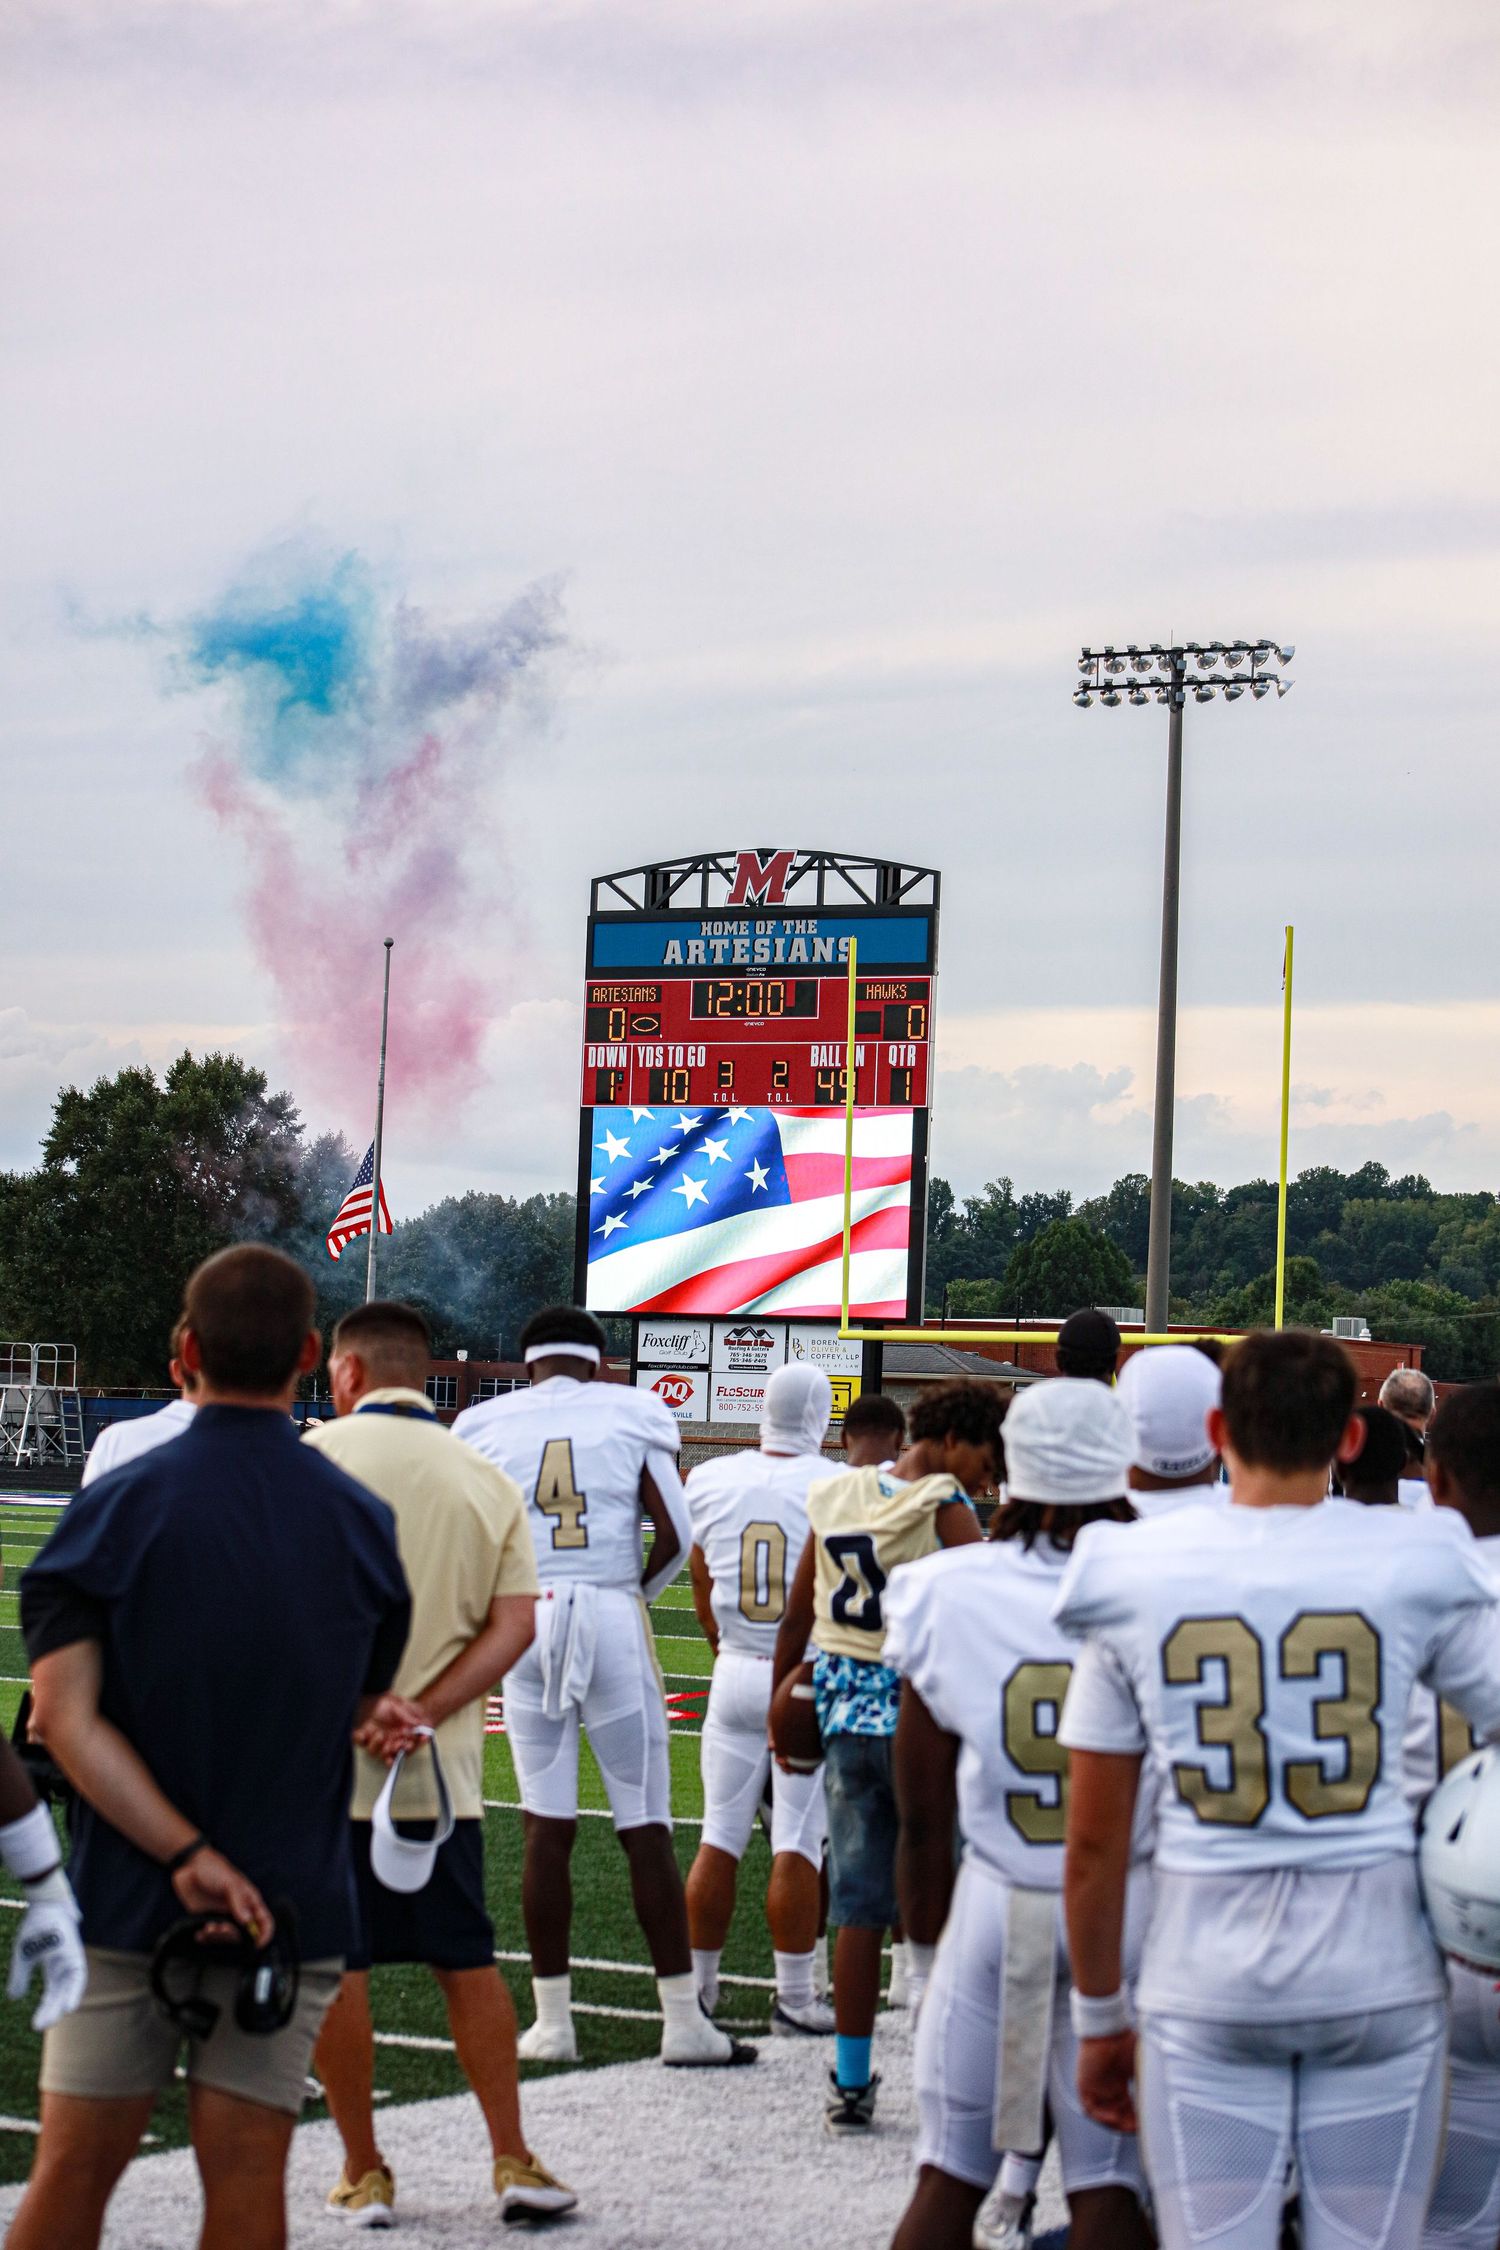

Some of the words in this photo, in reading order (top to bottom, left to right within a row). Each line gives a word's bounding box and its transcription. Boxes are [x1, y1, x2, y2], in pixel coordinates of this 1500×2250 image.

[725, 849, 798, 906] M
[701, 921, 749, 936] HOME
[755, 920, 776, 935] OF
[783, 919, 818, 935] THE
[662, 937, 850, 965] ARTESIANS
[592, 987, 657, 1002] ARTESIANS
[707, 981, 785, 1016] 12:00
[866, 984, 907, 999] HAWKS
[608, 1007, 626, 1041] 0
[907, 1005, 925, 1040] 0
[588, 1046, 627, 1068] DOWN
[638, 1046, 664, 1067] YDS
[668, 1046, 684, 1067] TO
[687, 1045, 706, 1066] GO
[810, 1045, 841, 1067] BALL
[888, 1044, 917, 1067] QTR
[610, 1071, 615, 1101] 1
[663, 1069, 689, 1103] 10
[720, 1061, 733, 1088] 3
[773, 1061, 788, 1088] 2
[905, 1071, 910, 1101] 1
[642, 1332, 691, 1351] Foxcliff
[658, 1381, 688, 1402] DQ
[718, 1403, 764, 1412] 800-752-59
[534, 1438, 588, 1550] 4
[738, 1520, 787, 1623] 0
[1162, 1610, 1384, 1827] 33
